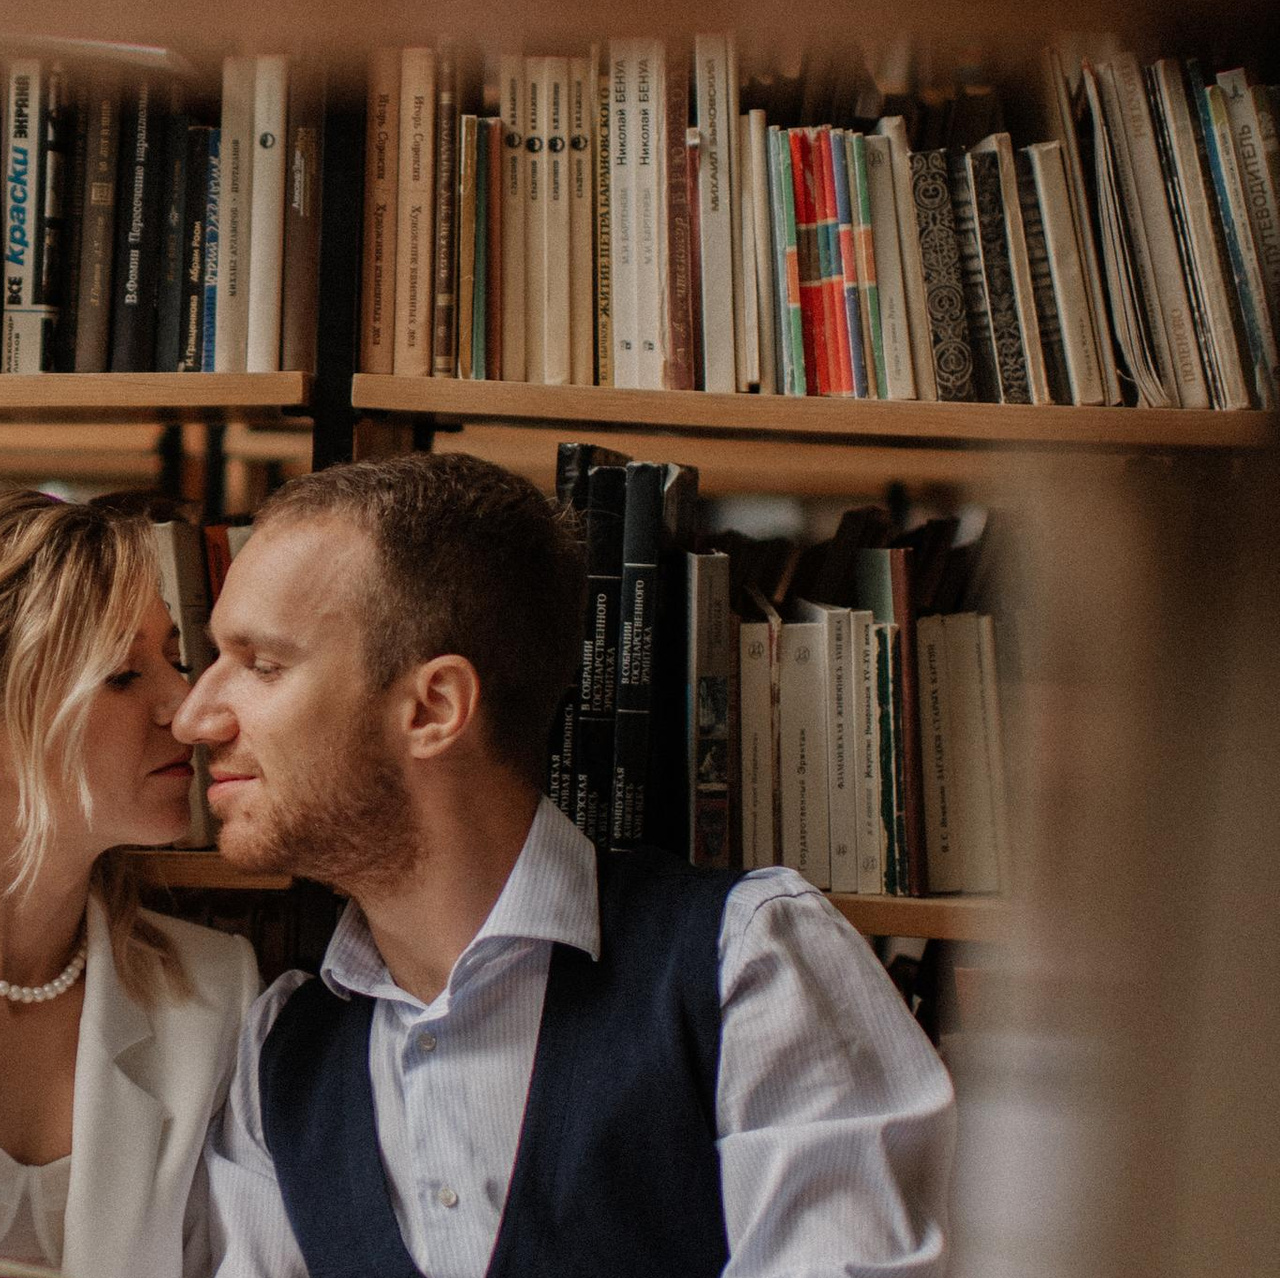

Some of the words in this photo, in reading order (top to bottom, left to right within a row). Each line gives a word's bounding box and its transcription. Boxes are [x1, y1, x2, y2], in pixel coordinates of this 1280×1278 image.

[11, 73, 32, 138] ЭКРАНА
[614, 58, 626, 103] БЕНУА
[637, 58, 650, 103] БЕНУА
[705, 57, 718, 146] БЫКОВСКИЙ
[376, 93, 390, 128] Игорь
[411, 95, 425, 129] Игорь
[615, 107, 627, 166] Николай
[637, 107, 651, 166] Николай
[374, 131, 389, 180] Сорокин
[409, 132, 424, 181] Сорокин
[597, 87, 611, 208] БАРАНОВСКОГО
[2, 145, 34, 265] краски
[127, 164, 146, 243] Пересечение
[708, 150, 720, 212] МИХАИЛ
[1238, 123, 1280, 265] ПУТЕВОДИТЕЛЬ
[190, 220, 202, 247] Роом
[372, 202, 387, 262] Художник
[407, 204, 422, 265] Художник
[597, 210, 612, 259] ПЕТРА
[5, 276, 22, 305] ВСЕ
[123, 248, 140, 304] В.Фомин
[187, 248, 202, 282] Абрам
[598, 261, 612, 318] ЖИТИЕ
[1170, 307, 1194, 382] ПОЛЕНОВО
[589, 593, 607, 712] ГОСУДАРСТВЕННОГО
[620, 621, 632, 677] СОБРАНИИ
[629, 579, 645, 685] ГОСУДАРСТВЕННОГО
[640, 625, 653, 684] ЭРМИТАЖА
[580, 640, 594, 700] СОБРАНИИ
[602, 645, 616, 710] ЭРМИТАЖА
[620, 677, 630, 685] В
[926, 643, 938, 684] КАРТИН
[560, 702, 574, 767] ЖИВОПИСЬ
[580, 703, 590, 712] В
[930, 688, 941, 731] СТАРЫХ
[796, 727, 808, 775] Эрмитаж
[933, 733, 945, 780] ЗАГАДКИ
[612, 766, 625, 839] ФРАНЦУЗСКАЯ
[797, 779, 808, 872] Государственный
